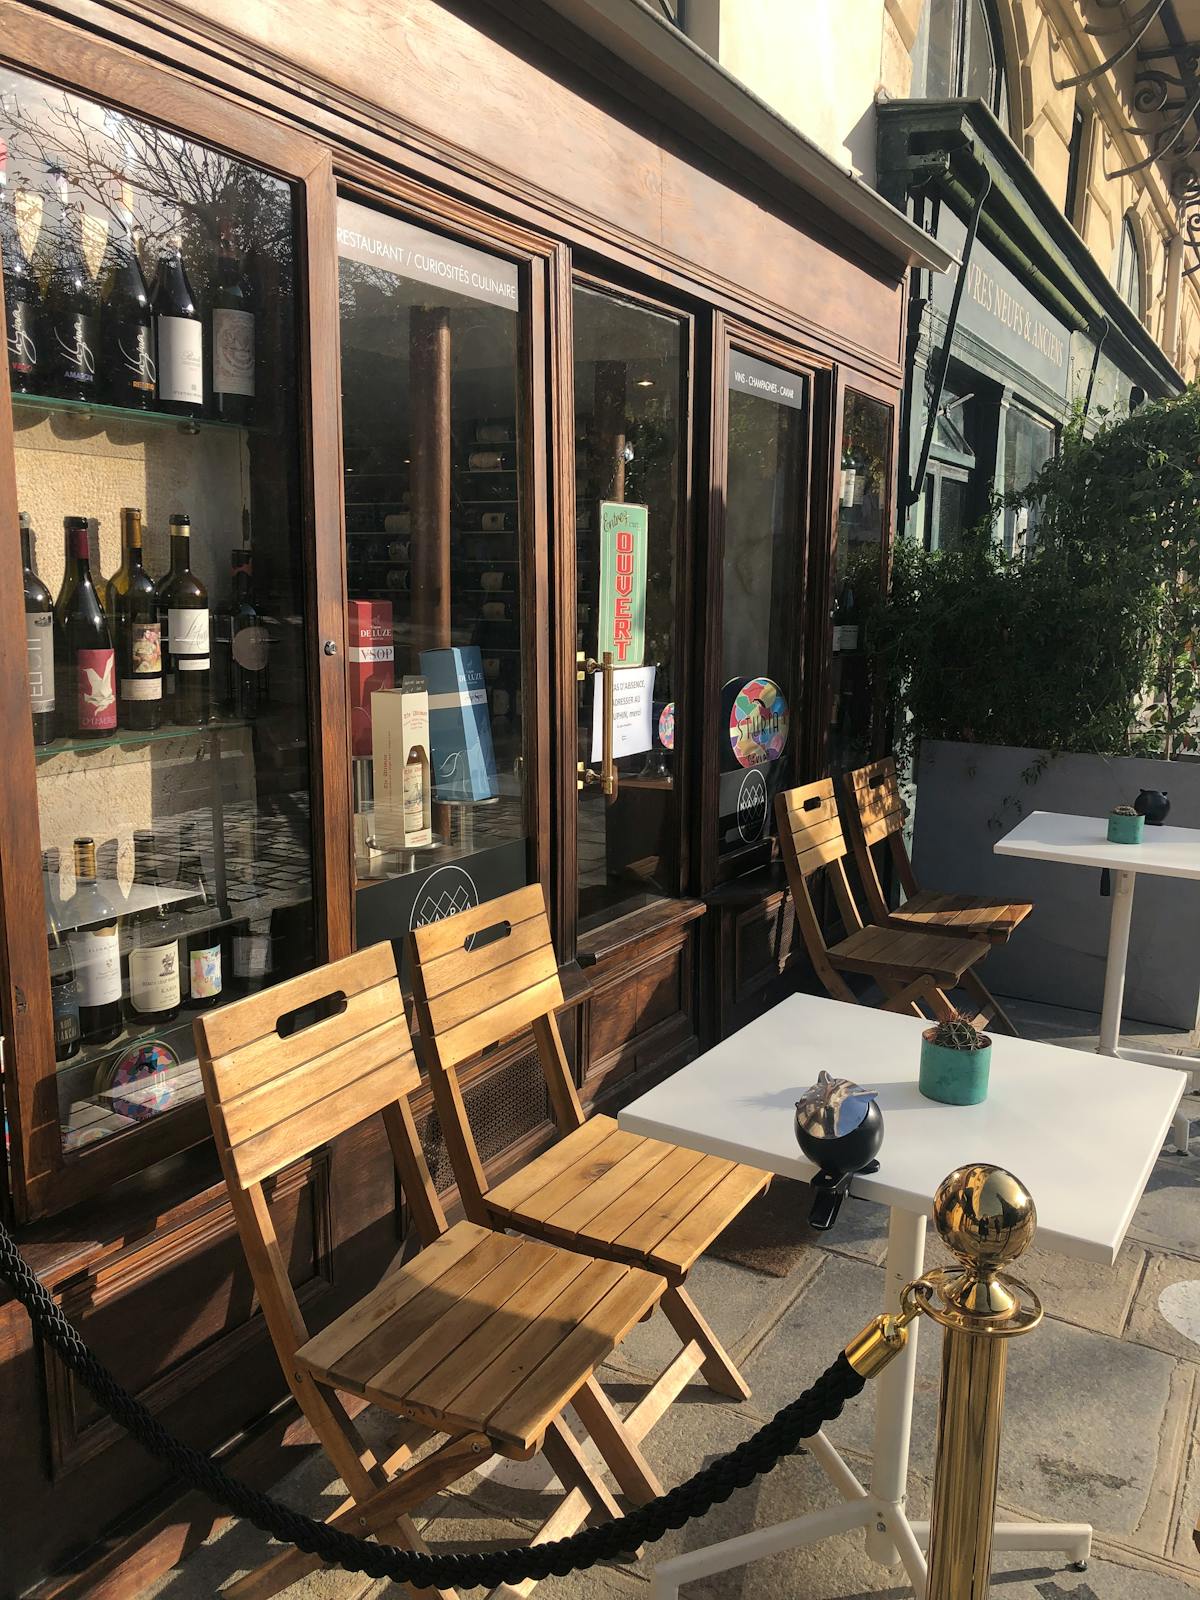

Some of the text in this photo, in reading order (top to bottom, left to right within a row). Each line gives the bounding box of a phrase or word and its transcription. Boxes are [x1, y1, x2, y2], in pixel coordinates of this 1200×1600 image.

[337, 228, 404, 263] RESTAURANT
[414, 254, 470, 286] CURIOSITÉS
[994, 284, 1024, 336] NEUFS
[1023, 311, 1032, 342] &
[1031, 319, 1064, 368] ANCIENS
[734, 371, 746, 384] VINS
[748, 376, 777, 394] CHAMPAGNES
[613, 531, 635, 661] OUVERT
